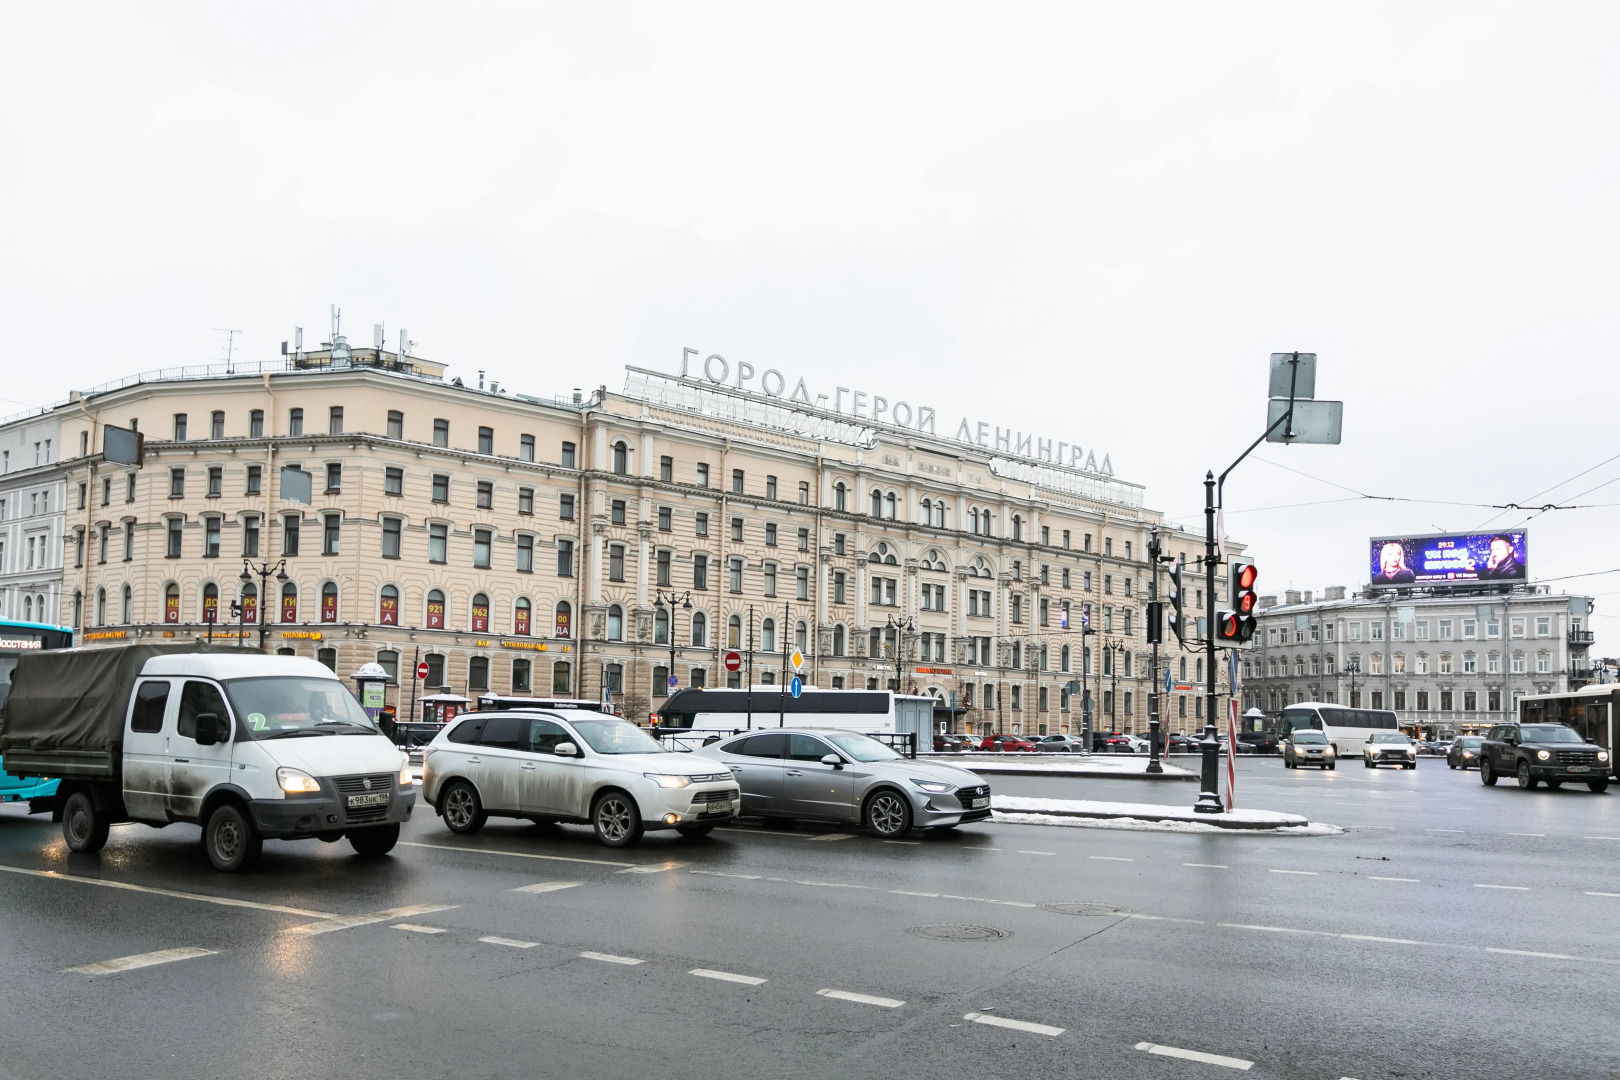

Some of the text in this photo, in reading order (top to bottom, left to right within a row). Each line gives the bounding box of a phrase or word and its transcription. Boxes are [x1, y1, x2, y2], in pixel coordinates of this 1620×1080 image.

[683, 347, 1114, 476] ГОРОД-ГЕРОЙ ЛЕНИНГРАД
[168, 598, 179, 607] НЕ
[284, 597, 296, 606] ГИ
[428, 605, 443, 613] 921
[473, 608, 487, 617] 962
[517, 612, 527, 620] 62
[558, 615, 567, 623] 00
[556, 627, 569, 635] ДА
[0, 638, 41, 649] осстания
[248, 713, 270, 731] 2
